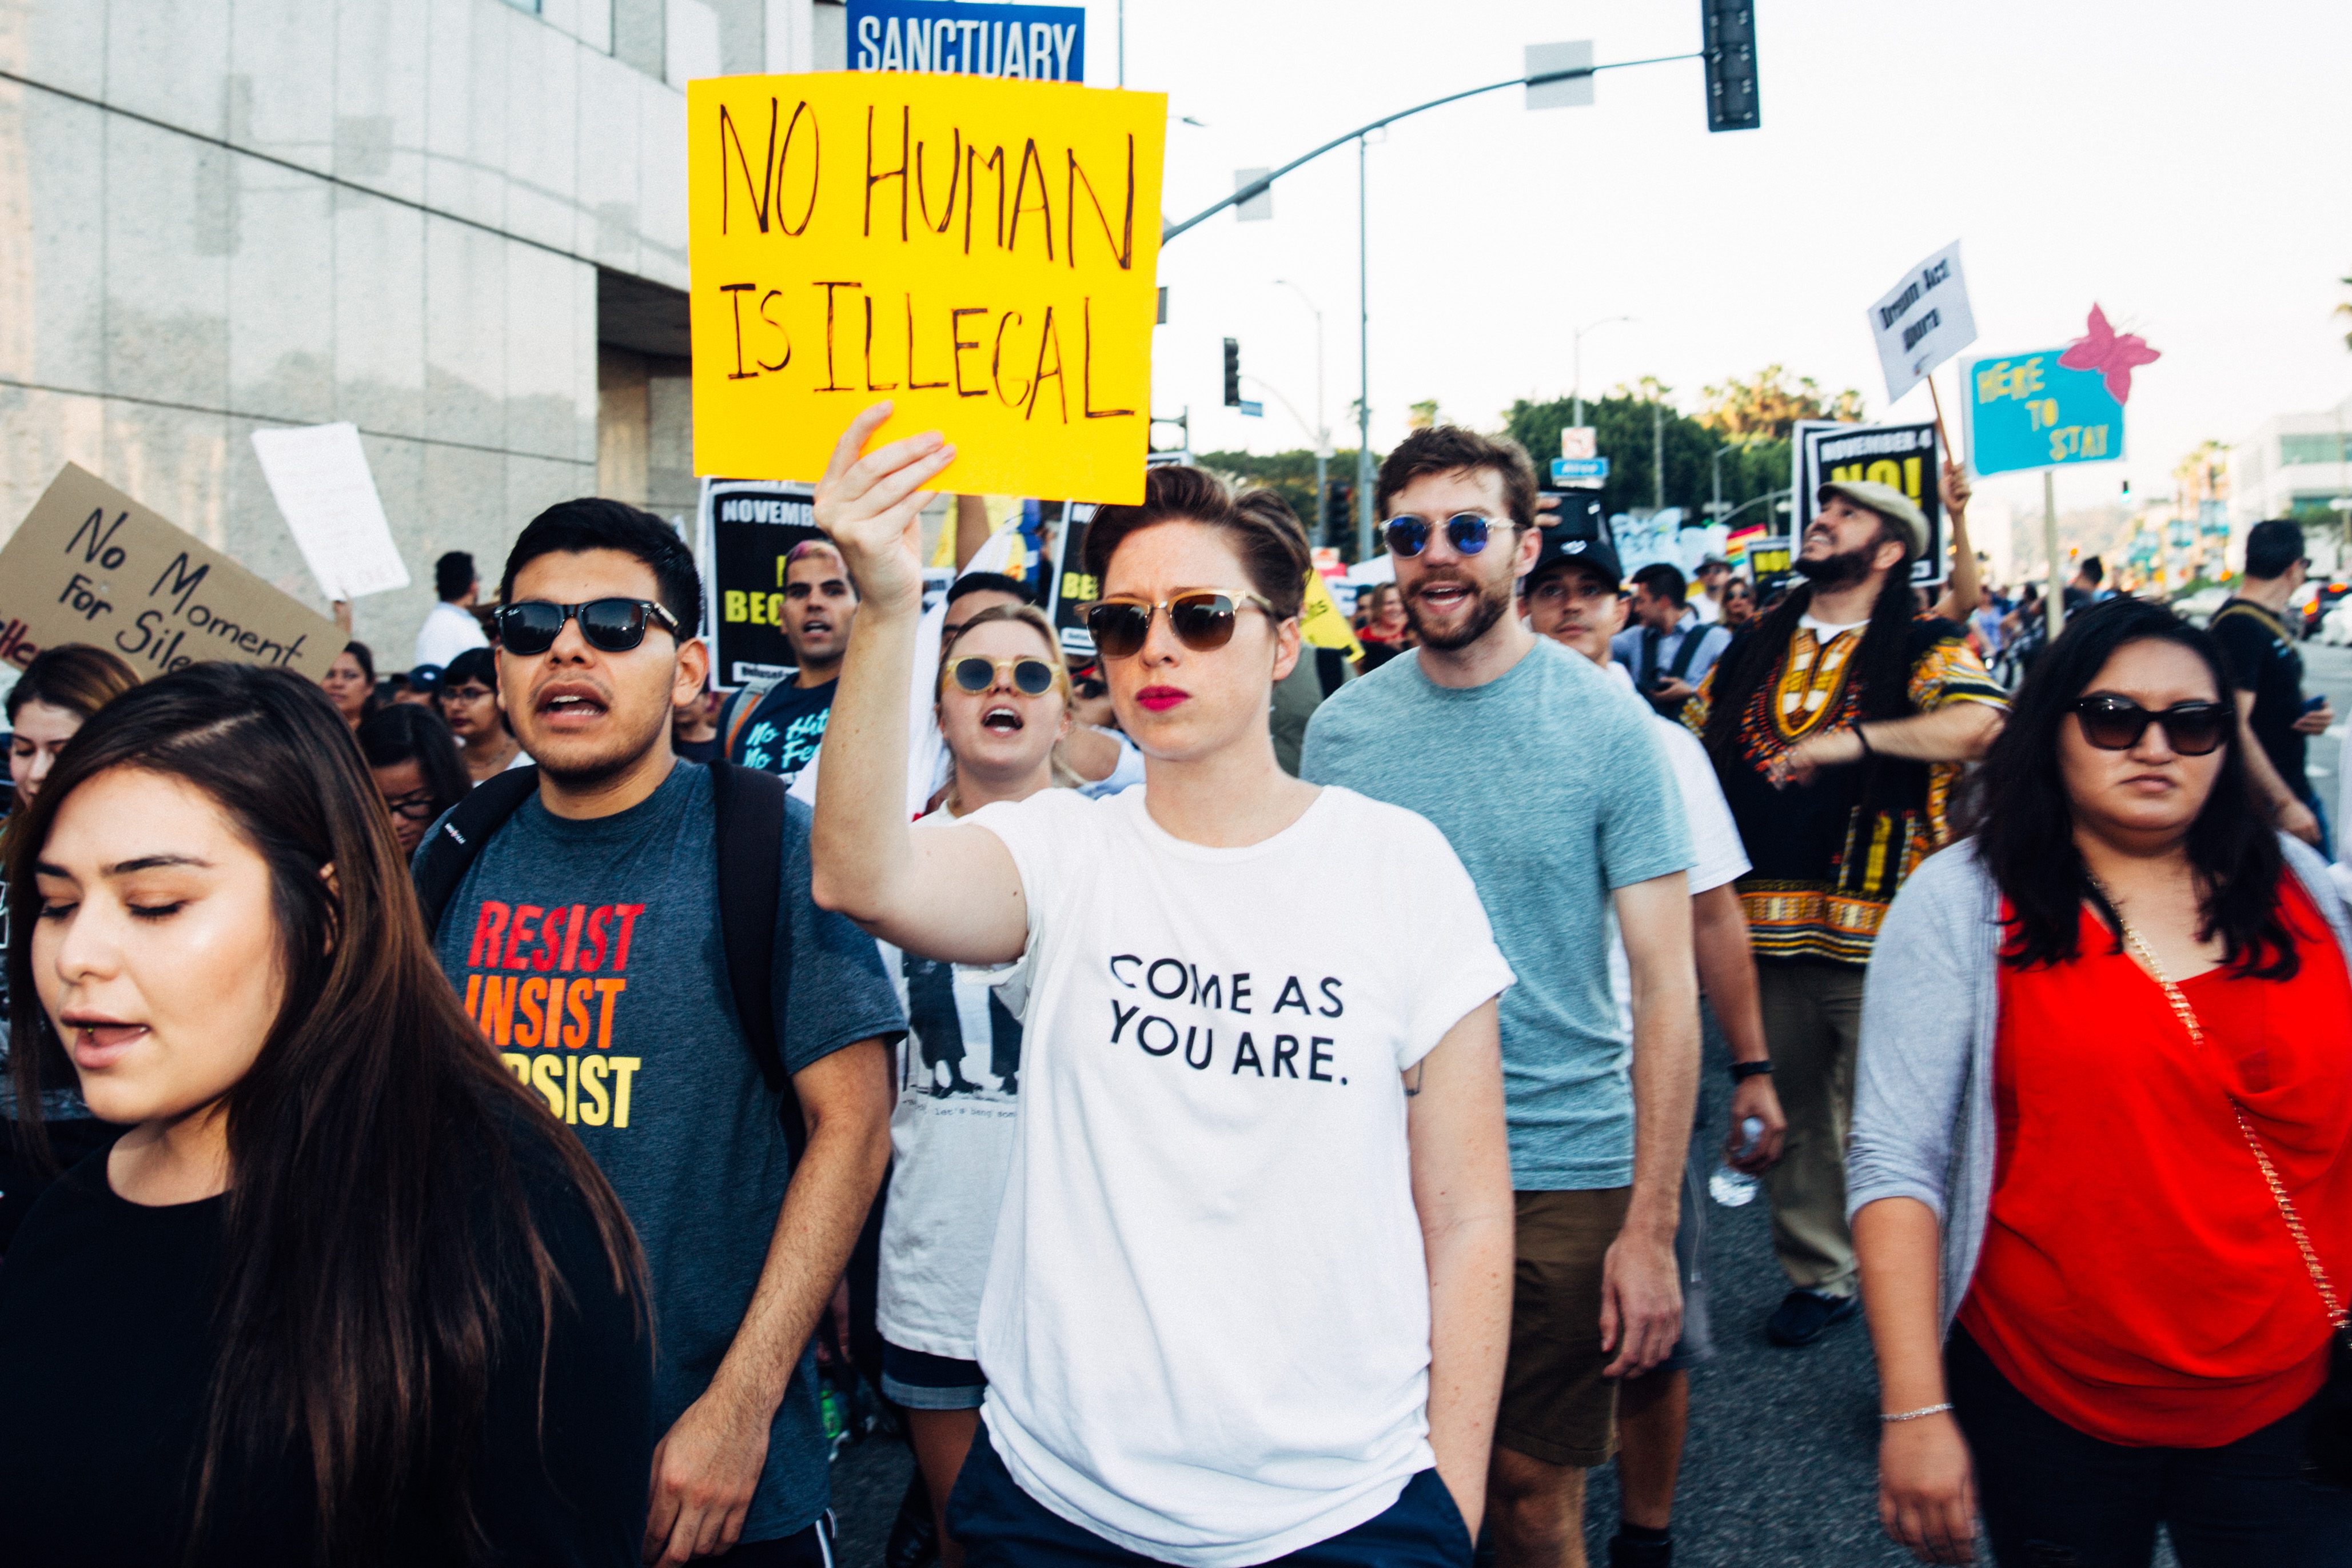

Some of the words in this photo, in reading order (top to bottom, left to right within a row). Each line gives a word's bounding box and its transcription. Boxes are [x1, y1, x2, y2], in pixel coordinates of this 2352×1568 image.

[857, 15, 1078, 83] SANCTUARY
[720, 97, 819, 236] NO
[864, 106, 1134, 270] HUMAN
[720, 283, 791, 380] IS
[812, 282, 1135, 424] ILLEGAL
[1976, 356, 2046, 405] HERE
[2024, 398, 2058, 432] TO
[2049, 424, 2108, 461] STAY
[721, 498, 817, 528] NOVEMB
[58, 573, 113, 621] For
[65, 508, 129, 570] No
[148, 551, 306, 666] Moment
[743, 747, 772, 769] No
[745, 721, 779, 747] No
[467, 900, 645, 972] RESIST
[463, 974, 627, 1050] INSIST
[1110, 954, 1251, 1015] COME
[1273, 976, 1344, 1019] AS
[1110, 999, 1213, 1070] YOU
[1232, 1031, 1348, 1086] ARE.
